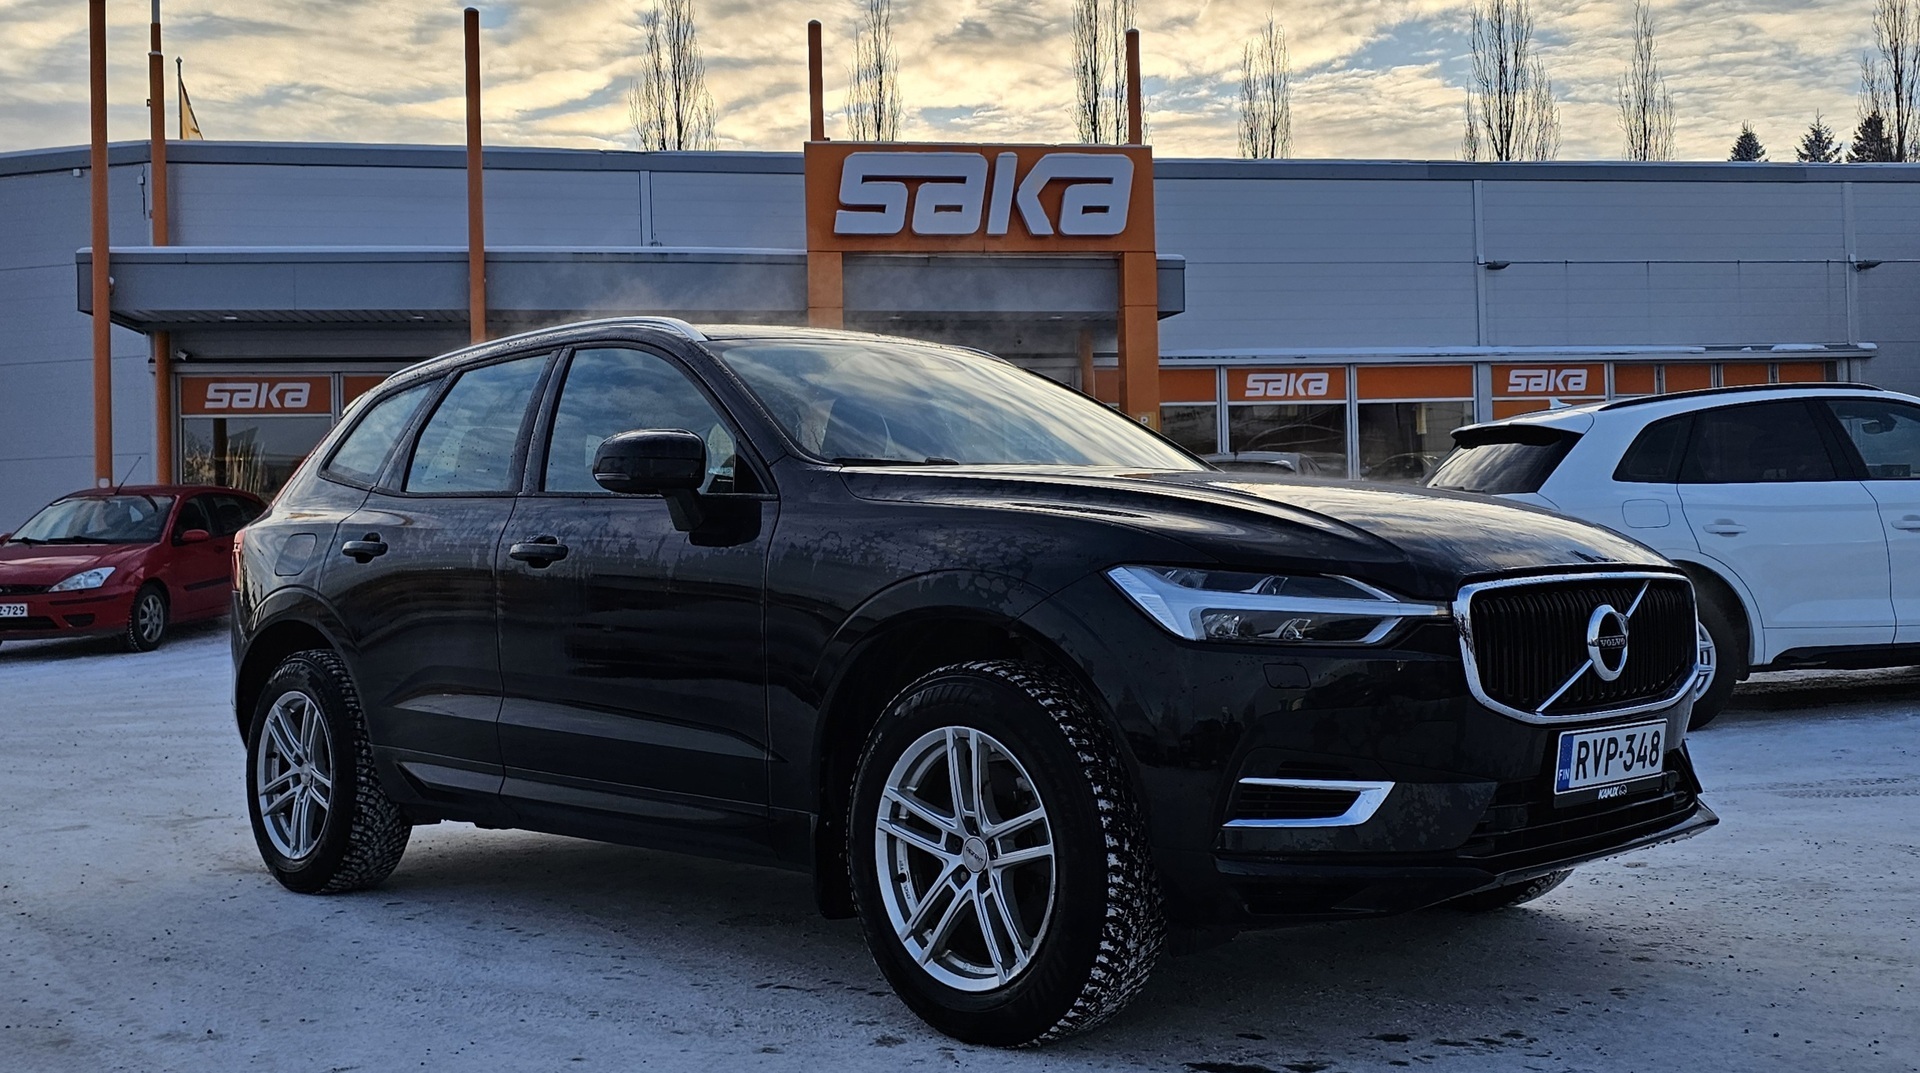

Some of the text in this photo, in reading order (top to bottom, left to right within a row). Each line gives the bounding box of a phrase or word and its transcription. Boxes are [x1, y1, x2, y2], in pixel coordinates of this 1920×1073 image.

[1599, 637, 1626, 647] VOLVO
[1575, 730, 1661, 781] RVP-348
[1558, 768, 1570, 782] FIN
